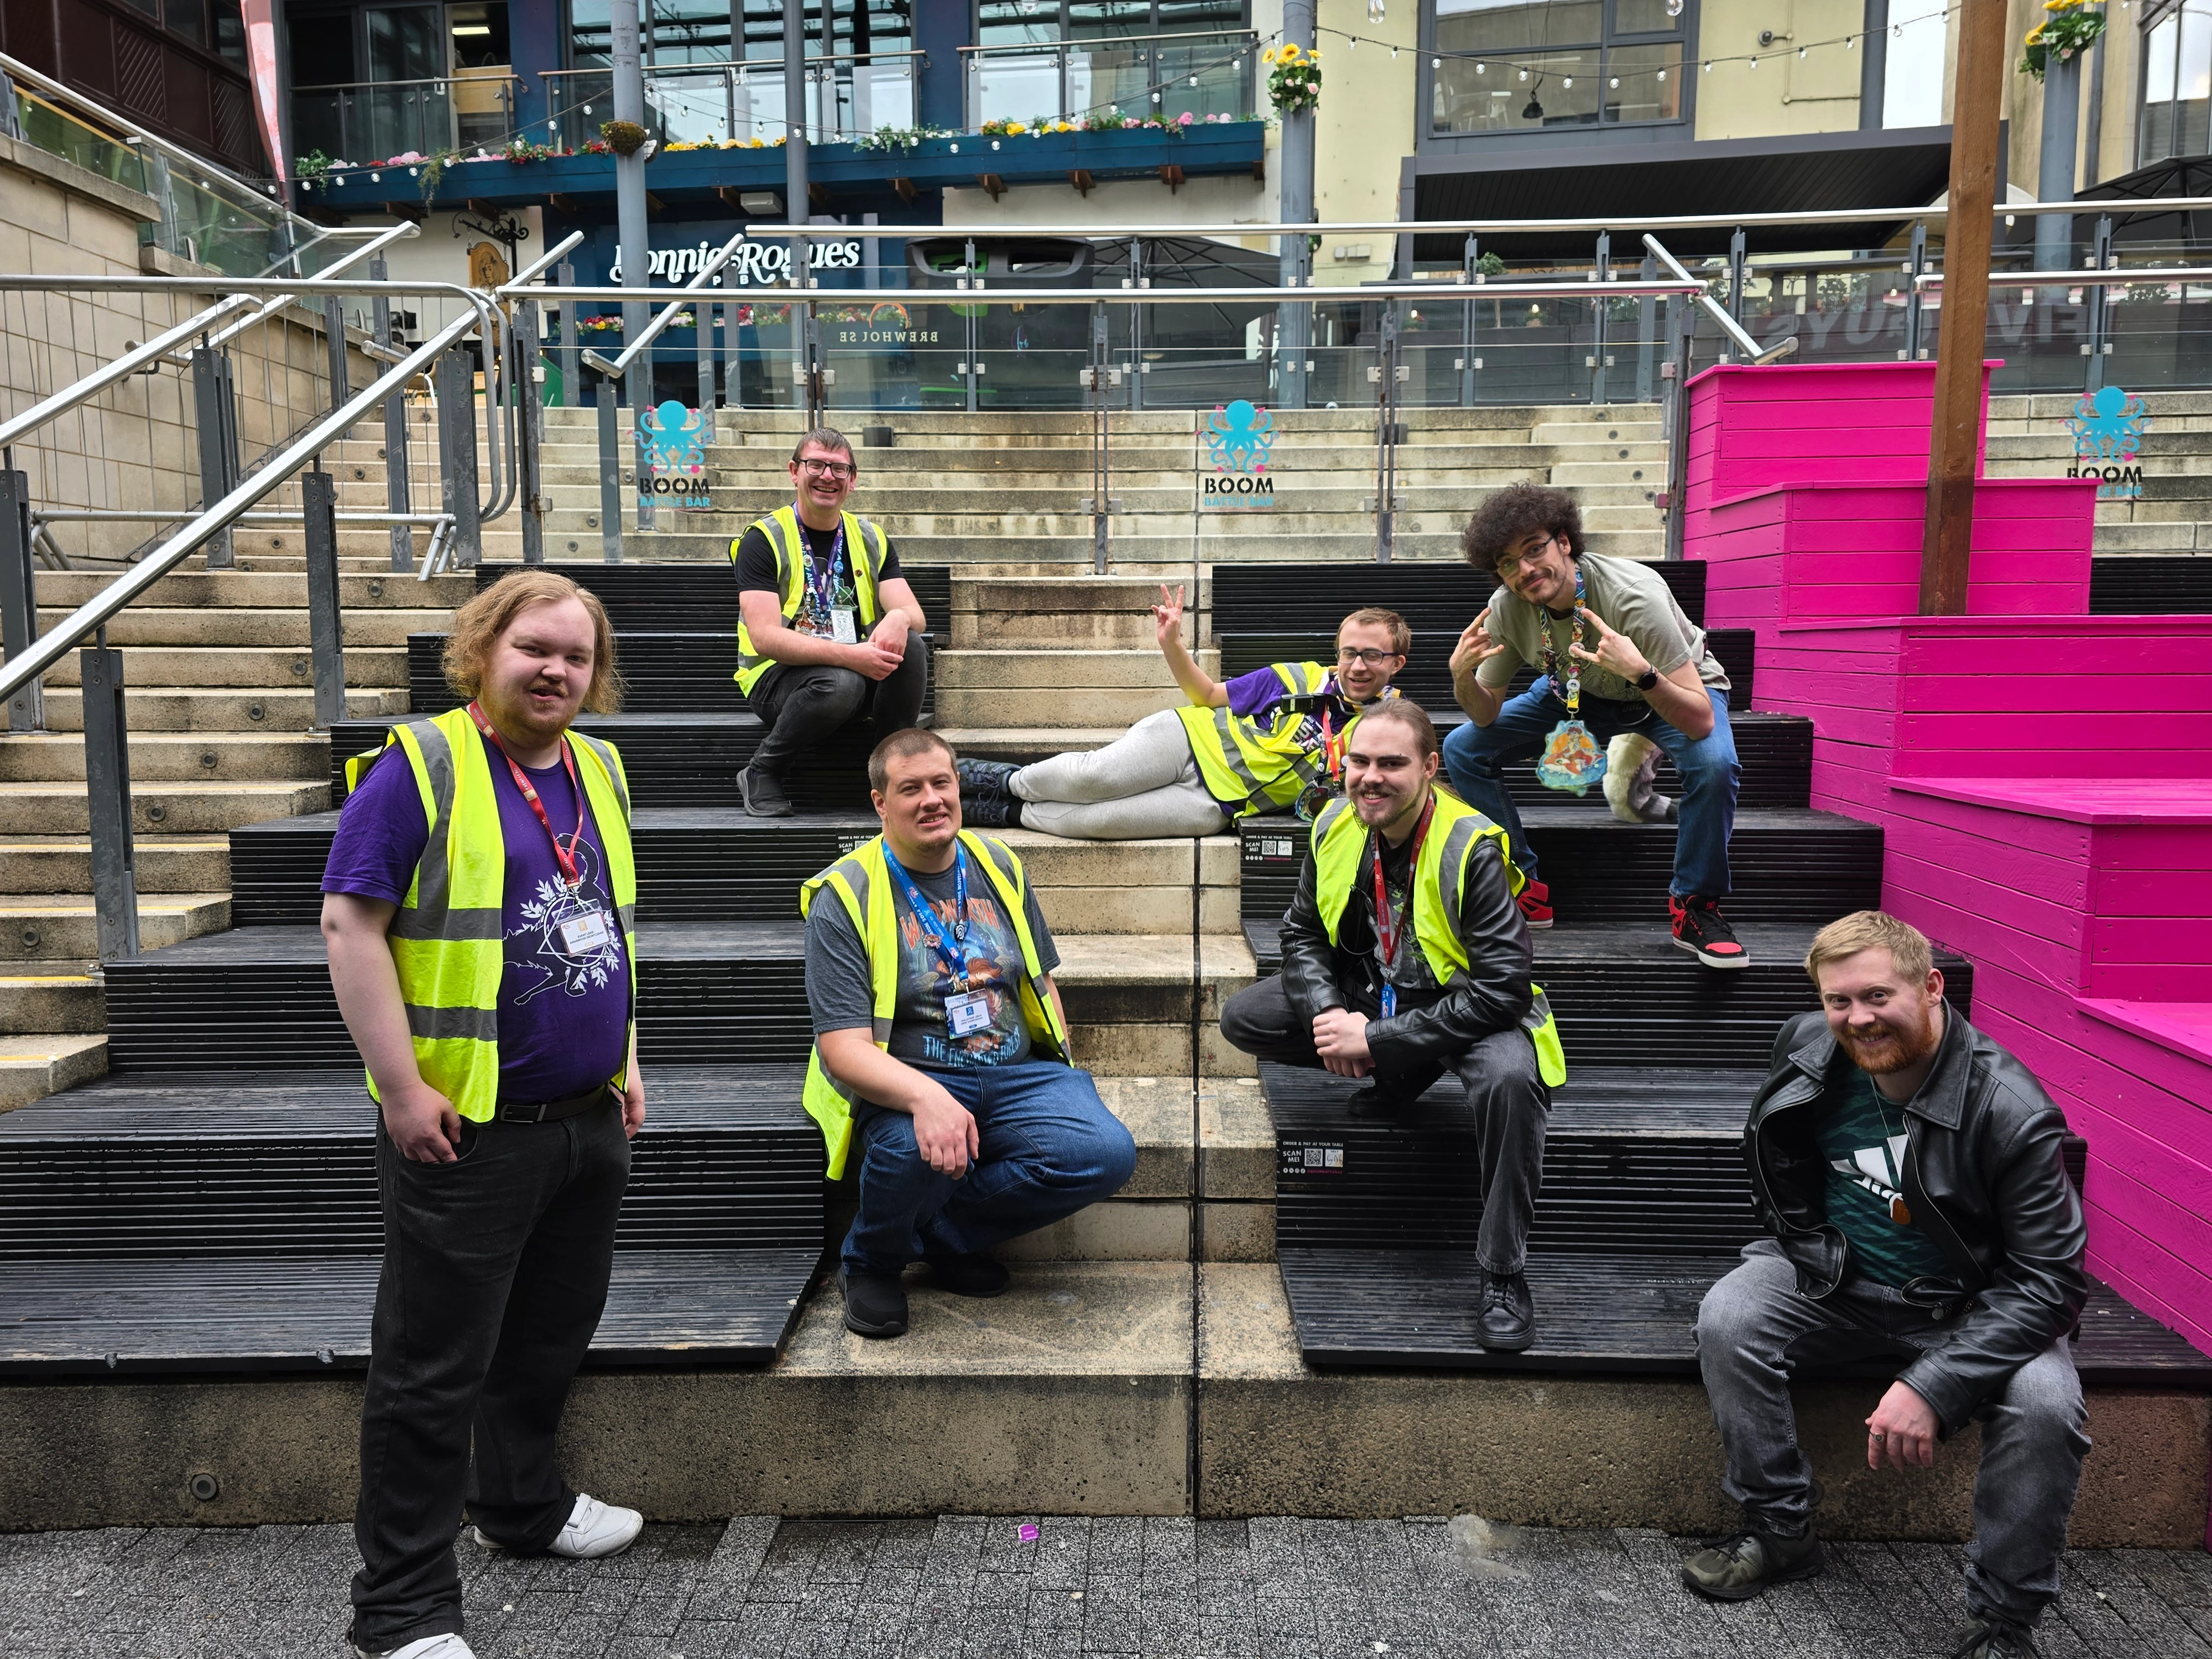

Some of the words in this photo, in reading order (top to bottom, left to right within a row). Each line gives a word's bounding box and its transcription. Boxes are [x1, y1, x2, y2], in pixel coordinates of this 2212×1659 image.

[712, 274, 749, 286] PB
[2067, 466, 2143, 484] BOOM
[639, 477, 710, 494] BOOM
[1205, 477, 1274, 494] BOOM
[640, 496, 682, 507] BATTLE
[686, 496, 711, 507] BAR
[1204, 496, 1245, 507] BATTLE
[1249, 496, 1274, 507] BAR
[899, 902, 942, 950] WD
[938, 897, 1000, 930] NRTH
[922, 1035, 947, 1062] THE
[1000, 1024, 1021, 1062] FOREST
